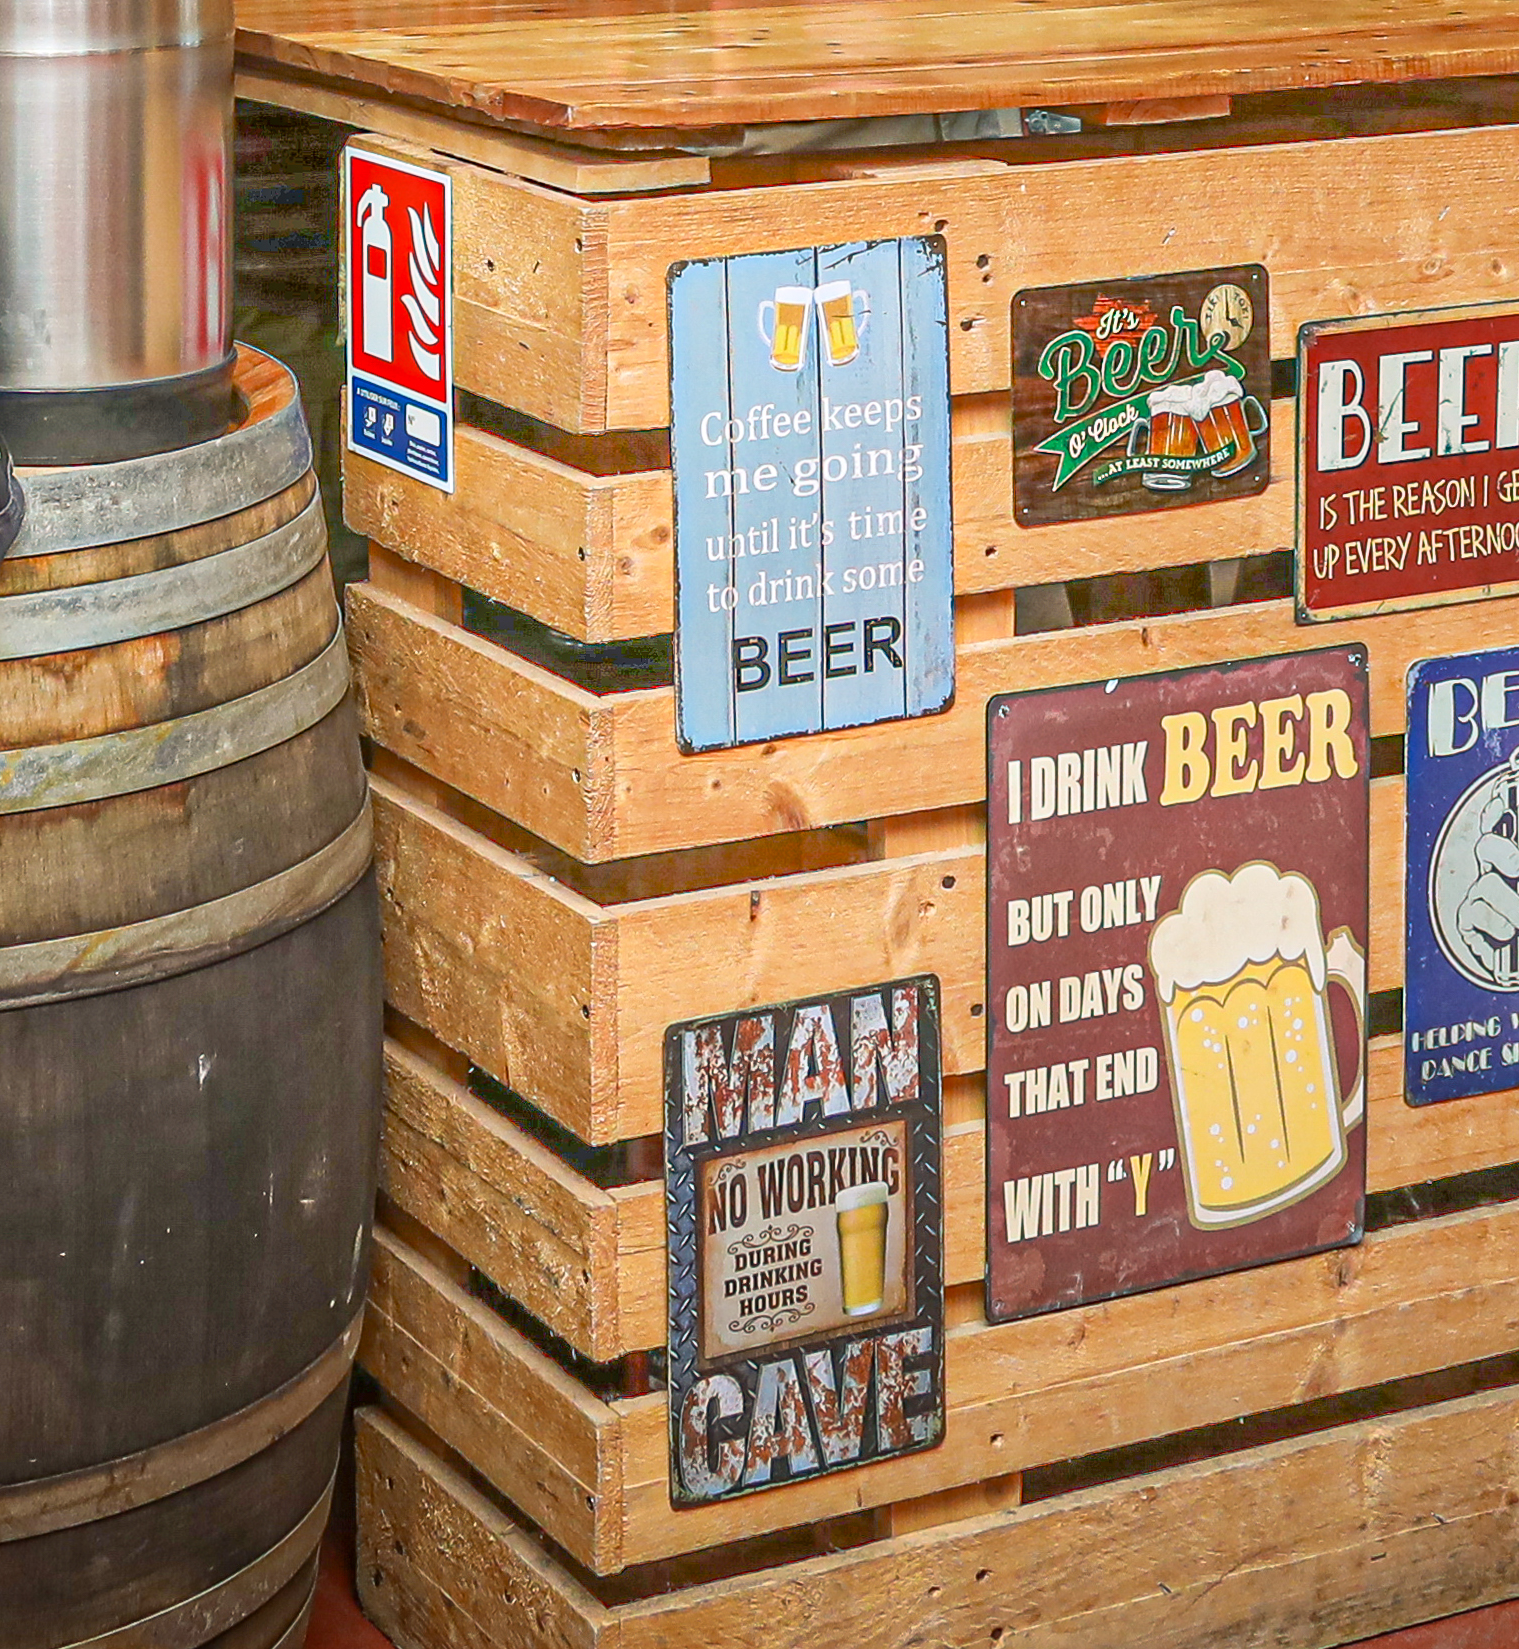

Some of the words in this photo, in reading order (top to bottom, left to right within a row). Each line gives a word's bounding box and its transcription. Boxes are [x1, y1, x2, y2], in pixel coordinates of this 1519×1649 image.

[1095, 307, 1140, 340] It's
[1037, 305, 1246, 423] Beer
[699, 402, 813, 447] Coffee
[824, 394, 923, 433] keeps
[704, 462, 779, 499] me
[791, 443, 925, 497] going
[1125, 457, 1159, 471] LEAST
[1162, 447, 1231, 471] SOMEWHERE
[1319, 493, 1338, 530] IS
[1343, 486, 1388, 525] THE
[1393, 475, 1475, 519] REASON
[1483, 474, 1490, 508] I
[706, 516, 779, 562] until
[848, 504, 928, 541] time
[1313, 544, 1340, 580] UP
[1345, 532, 1413, 576] EVERY
[706, 580, 740, 614] to
[747, 563, 835, 609] drink
[842, 557, 926, 594] some
[731, 614, 904, 693] BEER
[1007, 760, 1021, 825] I
[1030, 740, 1149, 820] DRINK
[1159, 687, 1359, 808] BEER
[1007, 891, 1073, 947] BUT
[1080, 875, 1162, 932] ONLY
[1005, 984, 1051, 1035] ON
[1059, 963, 1144, 1020] DAYS
[1411, 1016, 1502, 1053] HELPING
[684, 985, 919, 1151] MAN
[1004, 1059, 1087, 1119] THAT
[1095, 1046, 1159, 1102] END
[1421, 1047, 1493, 1082] DANCE
[707, 1167, 747, 1236] NO
[756, 1145, 901, 1221] WORKING
[1003, 1161, 1100, 1244] WITH
[723, 1258, 823, 1299] DRINKING
[733, 1237, 813, 1273] DURING
[738, 1284, 808, 1319] HOURS
[681, 1325, 932, 1496] CAVE
